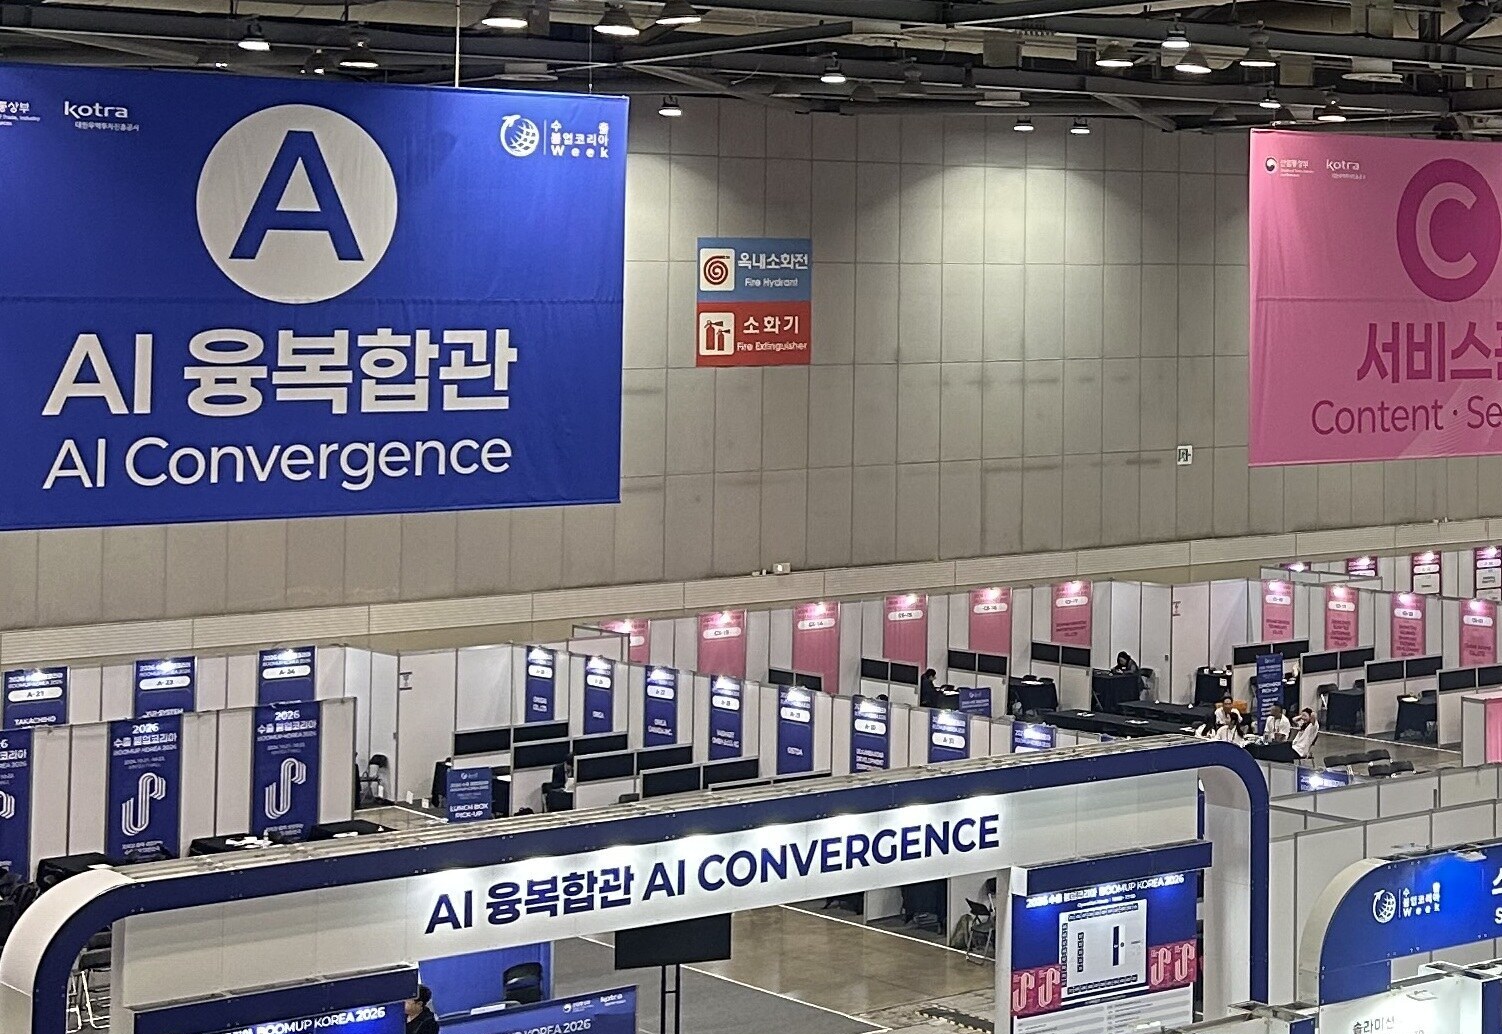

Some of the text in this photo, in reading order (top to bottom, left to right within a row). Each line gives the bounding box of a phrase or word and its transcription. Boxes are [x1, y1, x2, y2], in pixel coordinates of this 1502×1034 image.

[64, 101, 128, 119] kotra
[1326, 159, 1360, 171] kotra
[229, 130, 364, 261] A
[1415, 181, 1478, 280] C
[737, 253, 808, 270] 옥내소화전
[745, 278, 761, 287] Fire
[742, 316, 799, 334] 소화기
[737, 341, 753, 352] Fire
[41, 328, 518, 418] AI 융복합관
[1312, 399, 1444, 435] Content
[43, 436, 512, 491] AI Convergence
[425, 814, 1000, 935] AI 융복합관 AI CONVERGENCE
[314, 1010, 355, 1029] KOREA
[355, 1007, 386, 1022] 2026
[563, 1018, 591, 1033] 2026
